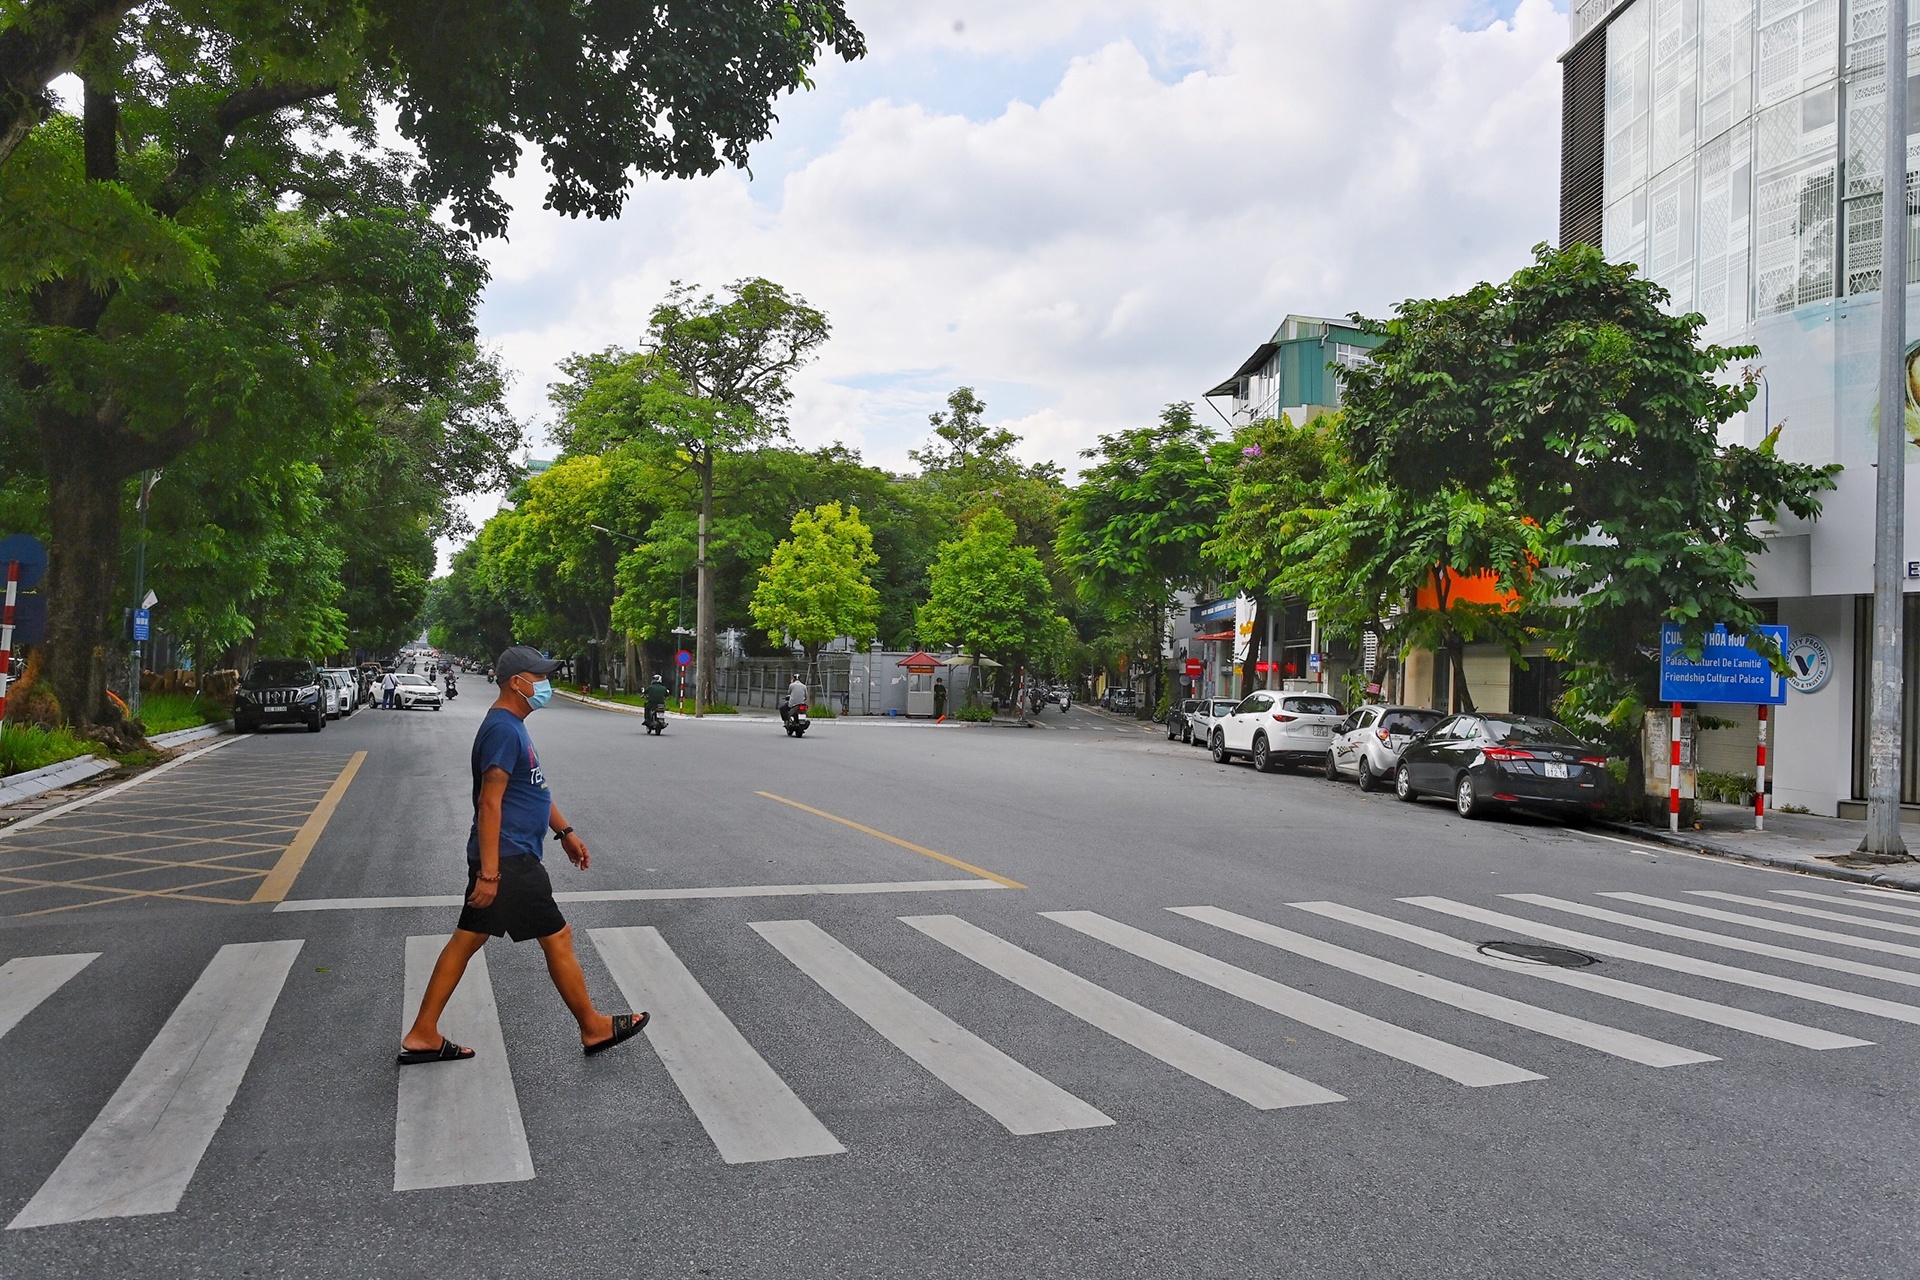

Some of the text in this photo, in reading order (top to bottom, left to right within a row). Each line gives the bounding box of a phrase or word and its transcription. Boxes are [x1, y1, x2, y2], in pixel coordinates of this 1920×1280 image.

[1665, 631, 1684, 645] CUN
[1787, 638, 1803, 664] UALITY
[1805, 637, 1827, 666] PROMISE
[1666, 656, 1688, 666] Palais
[1722, 658, 1732, 667] De
[1733, 658, 1762, 668] L'amitié
[1665, 672, 1765, 684] Friendship Cultural Palace
[1806, 670, 1824, 687] TRUSTED
